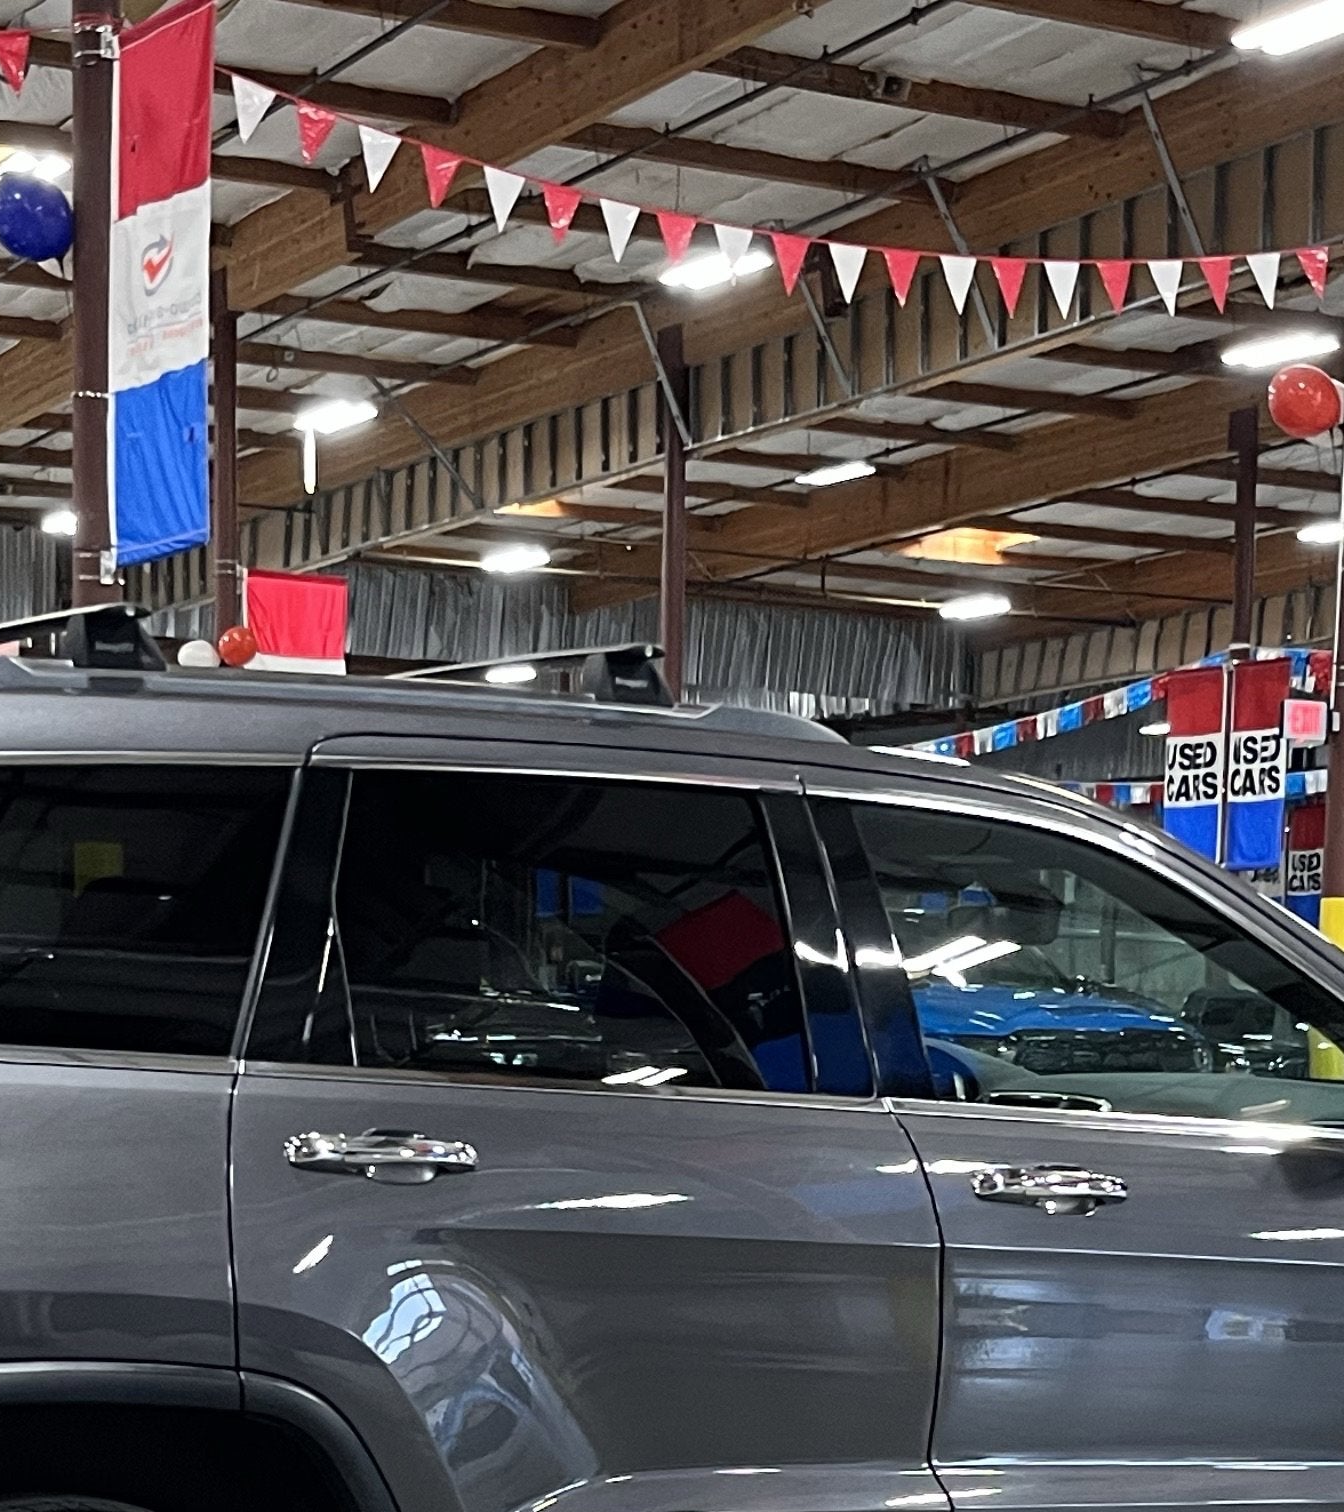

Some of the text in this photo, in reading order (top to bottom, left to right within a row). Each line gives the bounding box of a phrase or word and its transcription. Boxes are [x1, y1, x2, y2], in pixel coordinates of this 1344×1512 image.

[1167, 741, 1217, 771] USED
[1232, 734, 1281, 765] USED
[1166, 772, 1218, 801] CARS
[1230, 765, 1280, 796] CARS
[1291, 852, 1321, 872] USED
[1289, 872, 1321, 892] CARS
